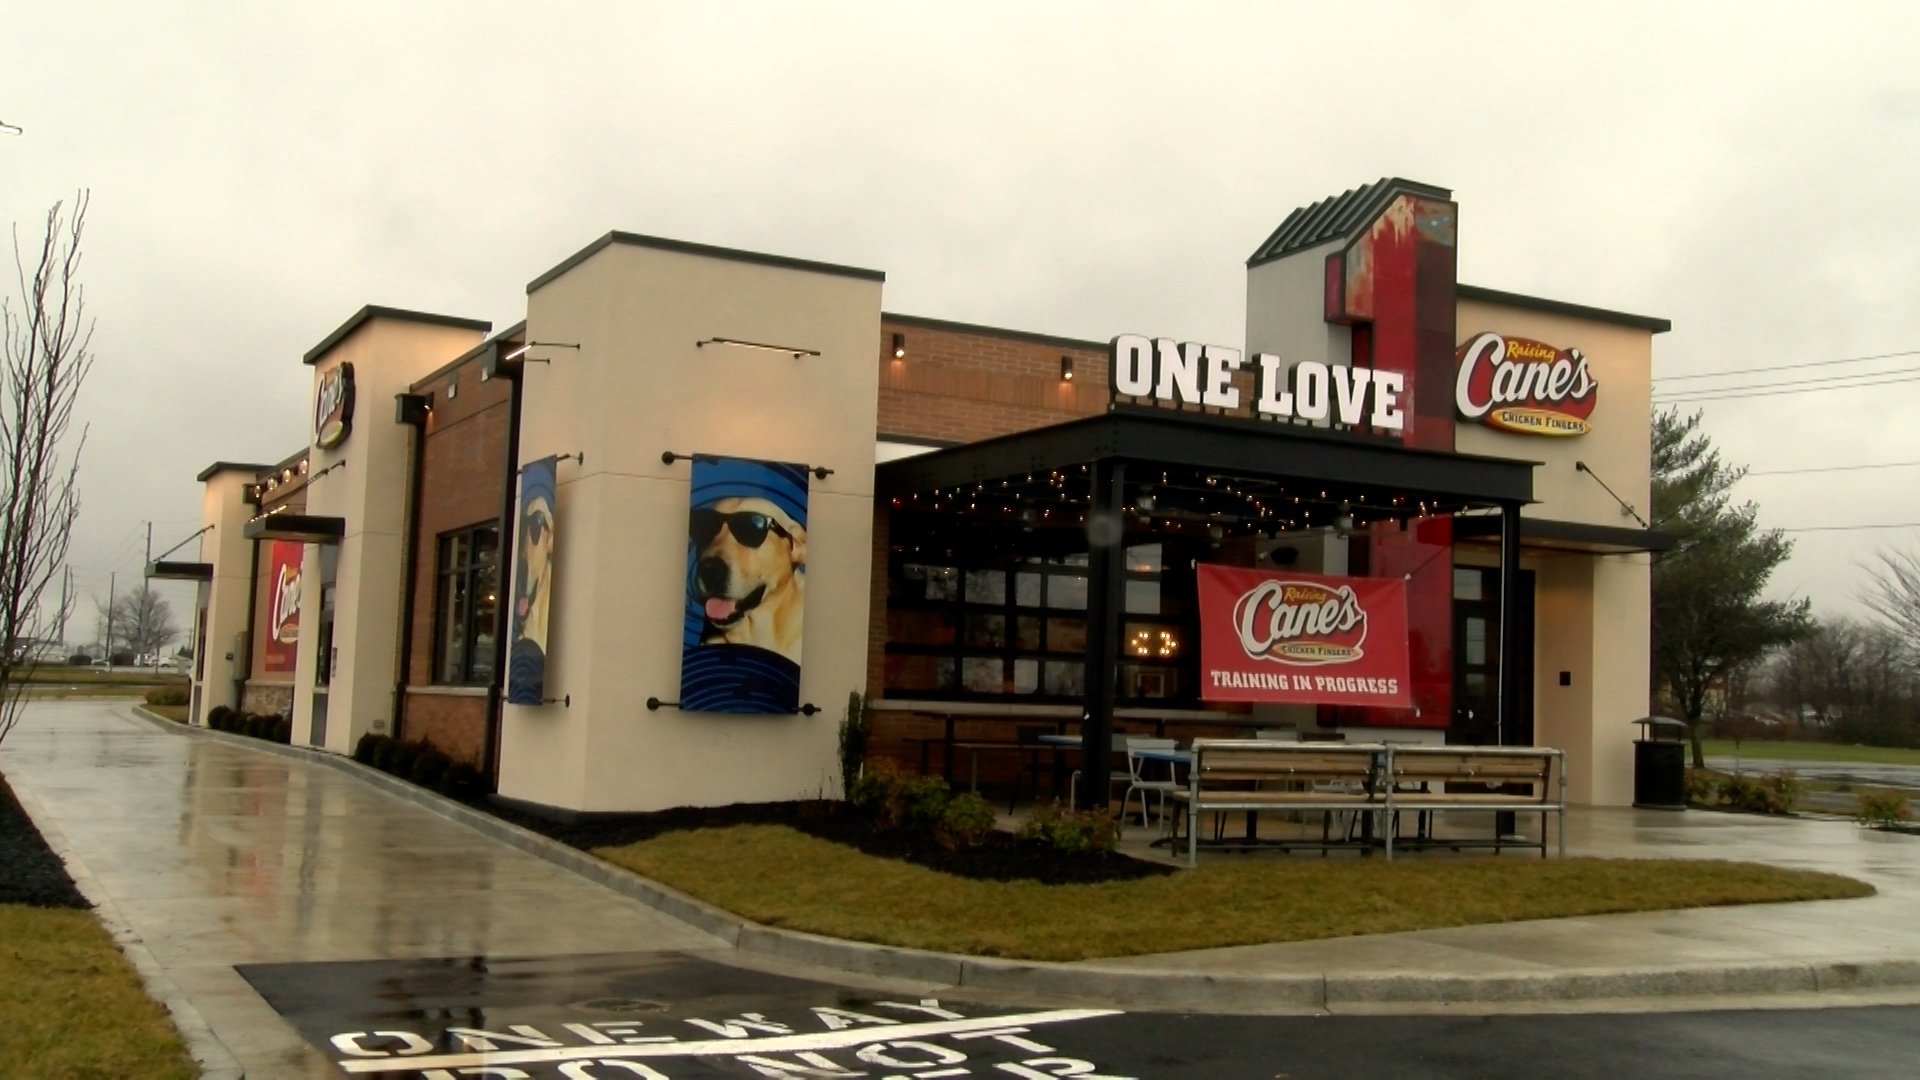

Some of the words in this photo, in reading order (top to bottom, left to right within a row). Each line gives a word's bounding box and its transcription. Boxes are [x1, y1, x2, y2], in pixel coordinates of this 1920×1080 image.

[1456, 333, 1597, 418] Cane's
[1506, 340, 1556, 364] Raising
[1114, 334, 1242, 408] ONE
[1258, 353, 1404, 430] LOVE
[1502, 411, 1542, 426] CHICKEN
[1545, 417, 1584, 432] FINGERS
[1242, 580, 1362, 653] Cane's
[1284, 586, 1327, 604] Raising
[1211, 670, 1289, 690] TRAINING
[1293, 675, 1313, 690] IN
[1315, 676, 1399, 694] PROGRESS
[329, 1021, 679, 1057] ONE
[683, 999, 966, 1038] WAY
[735, 1027, 1056, 1080] NOT
